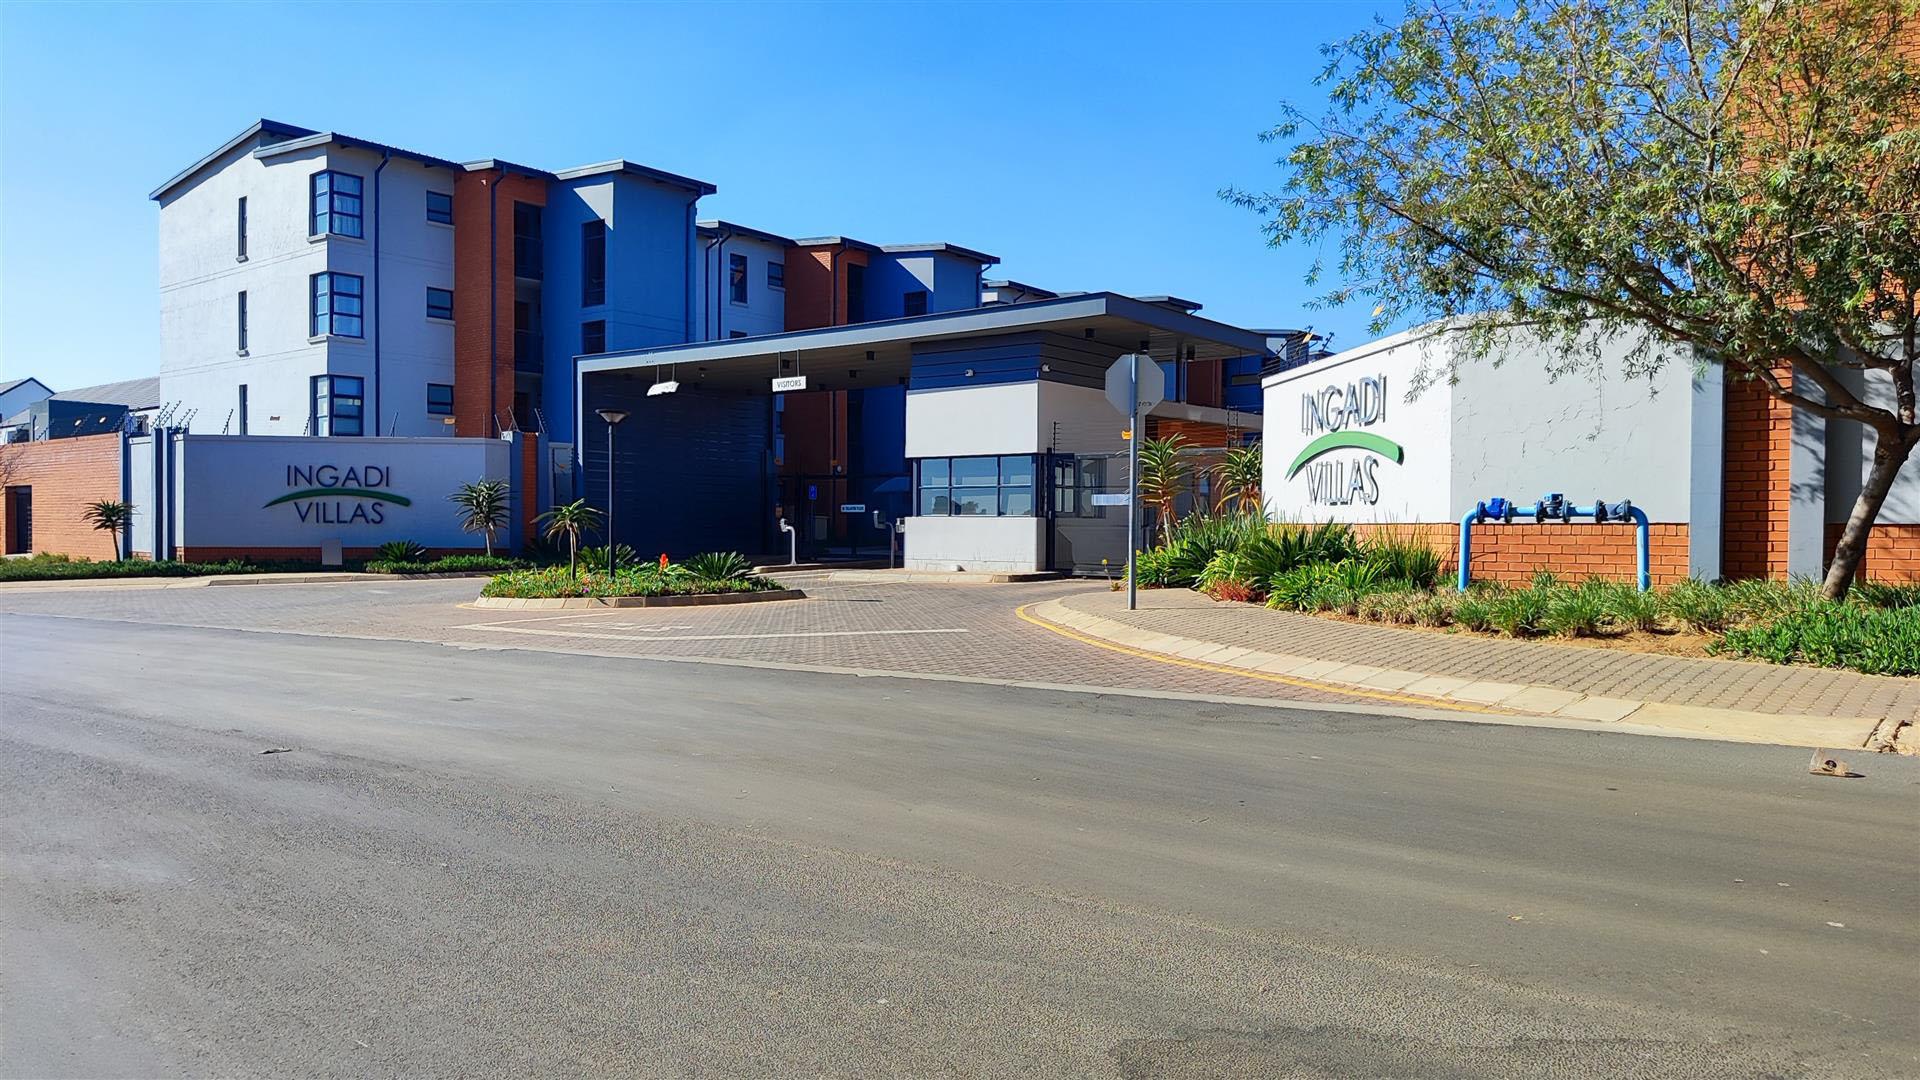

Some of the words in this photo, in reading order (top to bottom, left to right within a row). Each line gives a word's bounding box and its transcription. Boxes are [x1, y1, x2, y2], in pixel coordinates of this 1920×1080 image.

[776, 379, 802, 389] VISITORS
[1301, 373, 1387, 436] INGADI
[286, 464, 390, 488] INGADI
[1305, 455, 1379, 506] VILLAS
[294, 501, 384, 525] VILLAS
